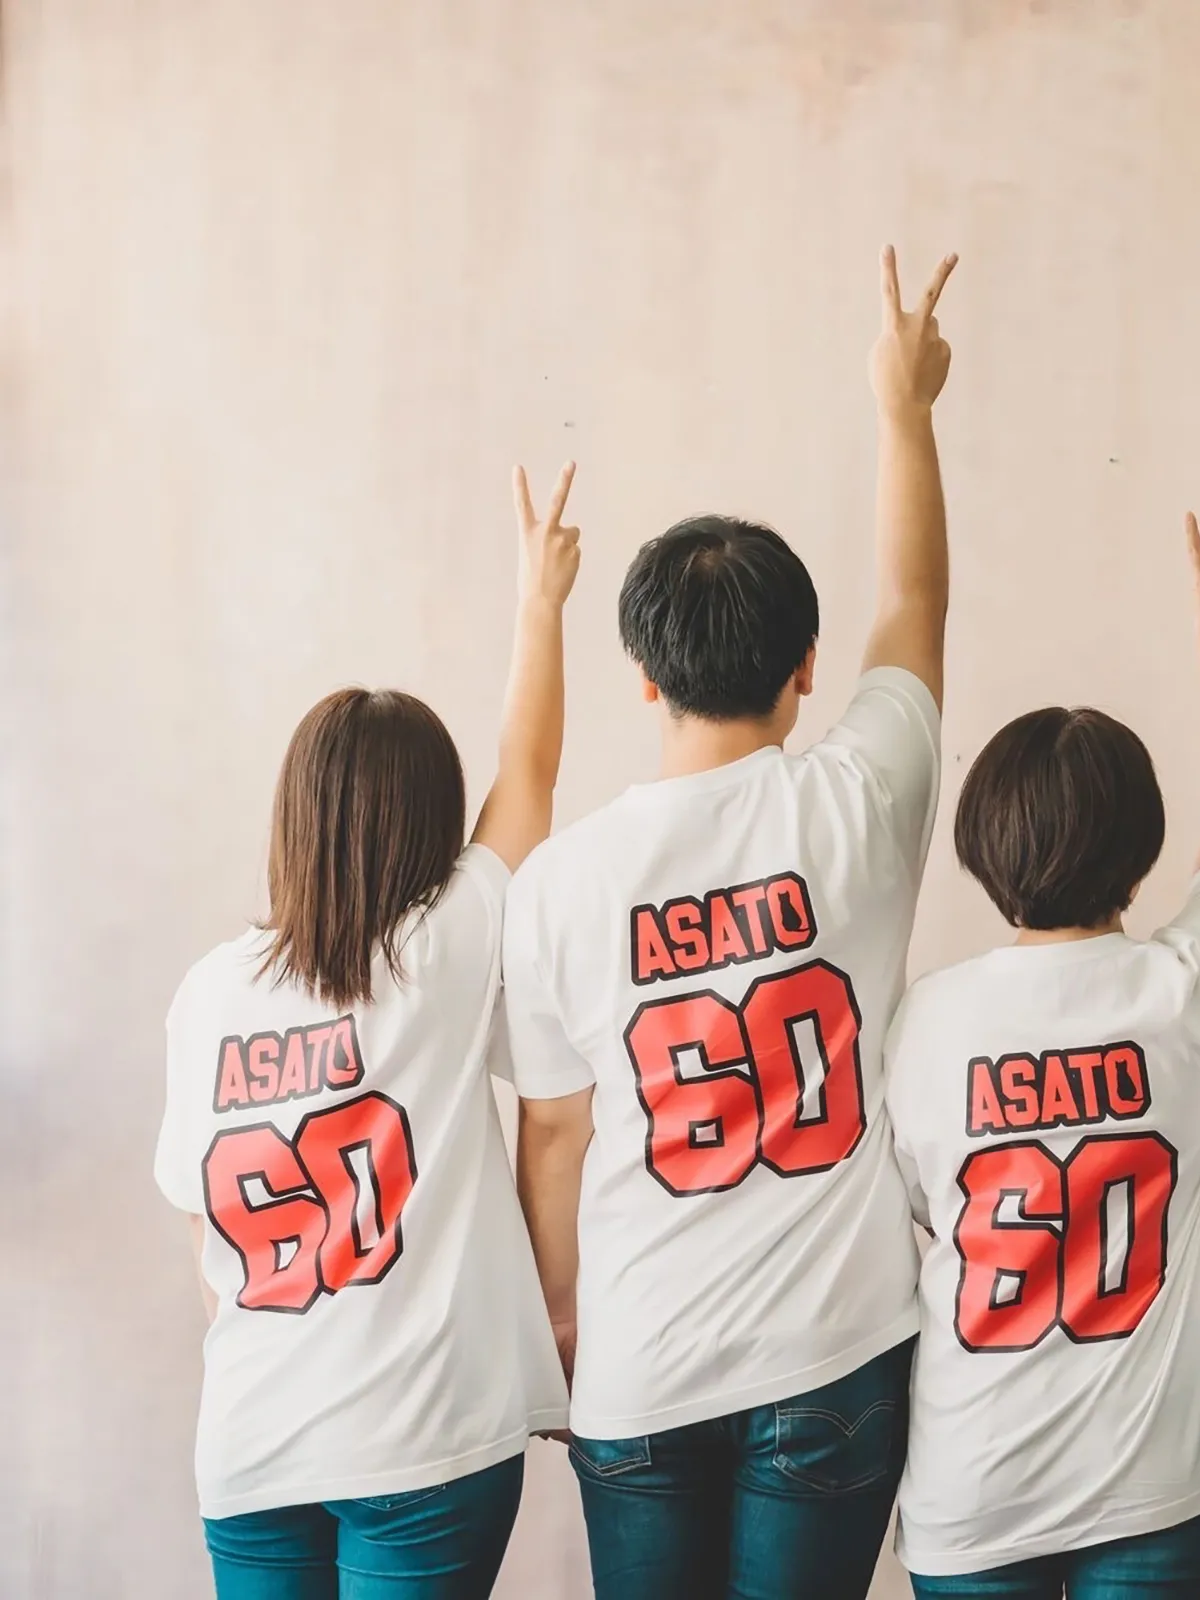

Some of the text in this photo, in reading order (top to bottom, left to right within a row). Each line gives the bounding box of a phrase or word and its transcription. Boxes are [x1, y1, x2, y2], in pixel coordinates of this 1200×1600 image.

[630, 871, 818, 986] ASATO
[213, 1013, 365, 1113] ASATO
[623, 958, 867, 1198] 60
[966, 1040, 1152, 1137] ASATO
[202, 1090, 418, 1315] 60
[953, 1130, 1178, 1354] 60
